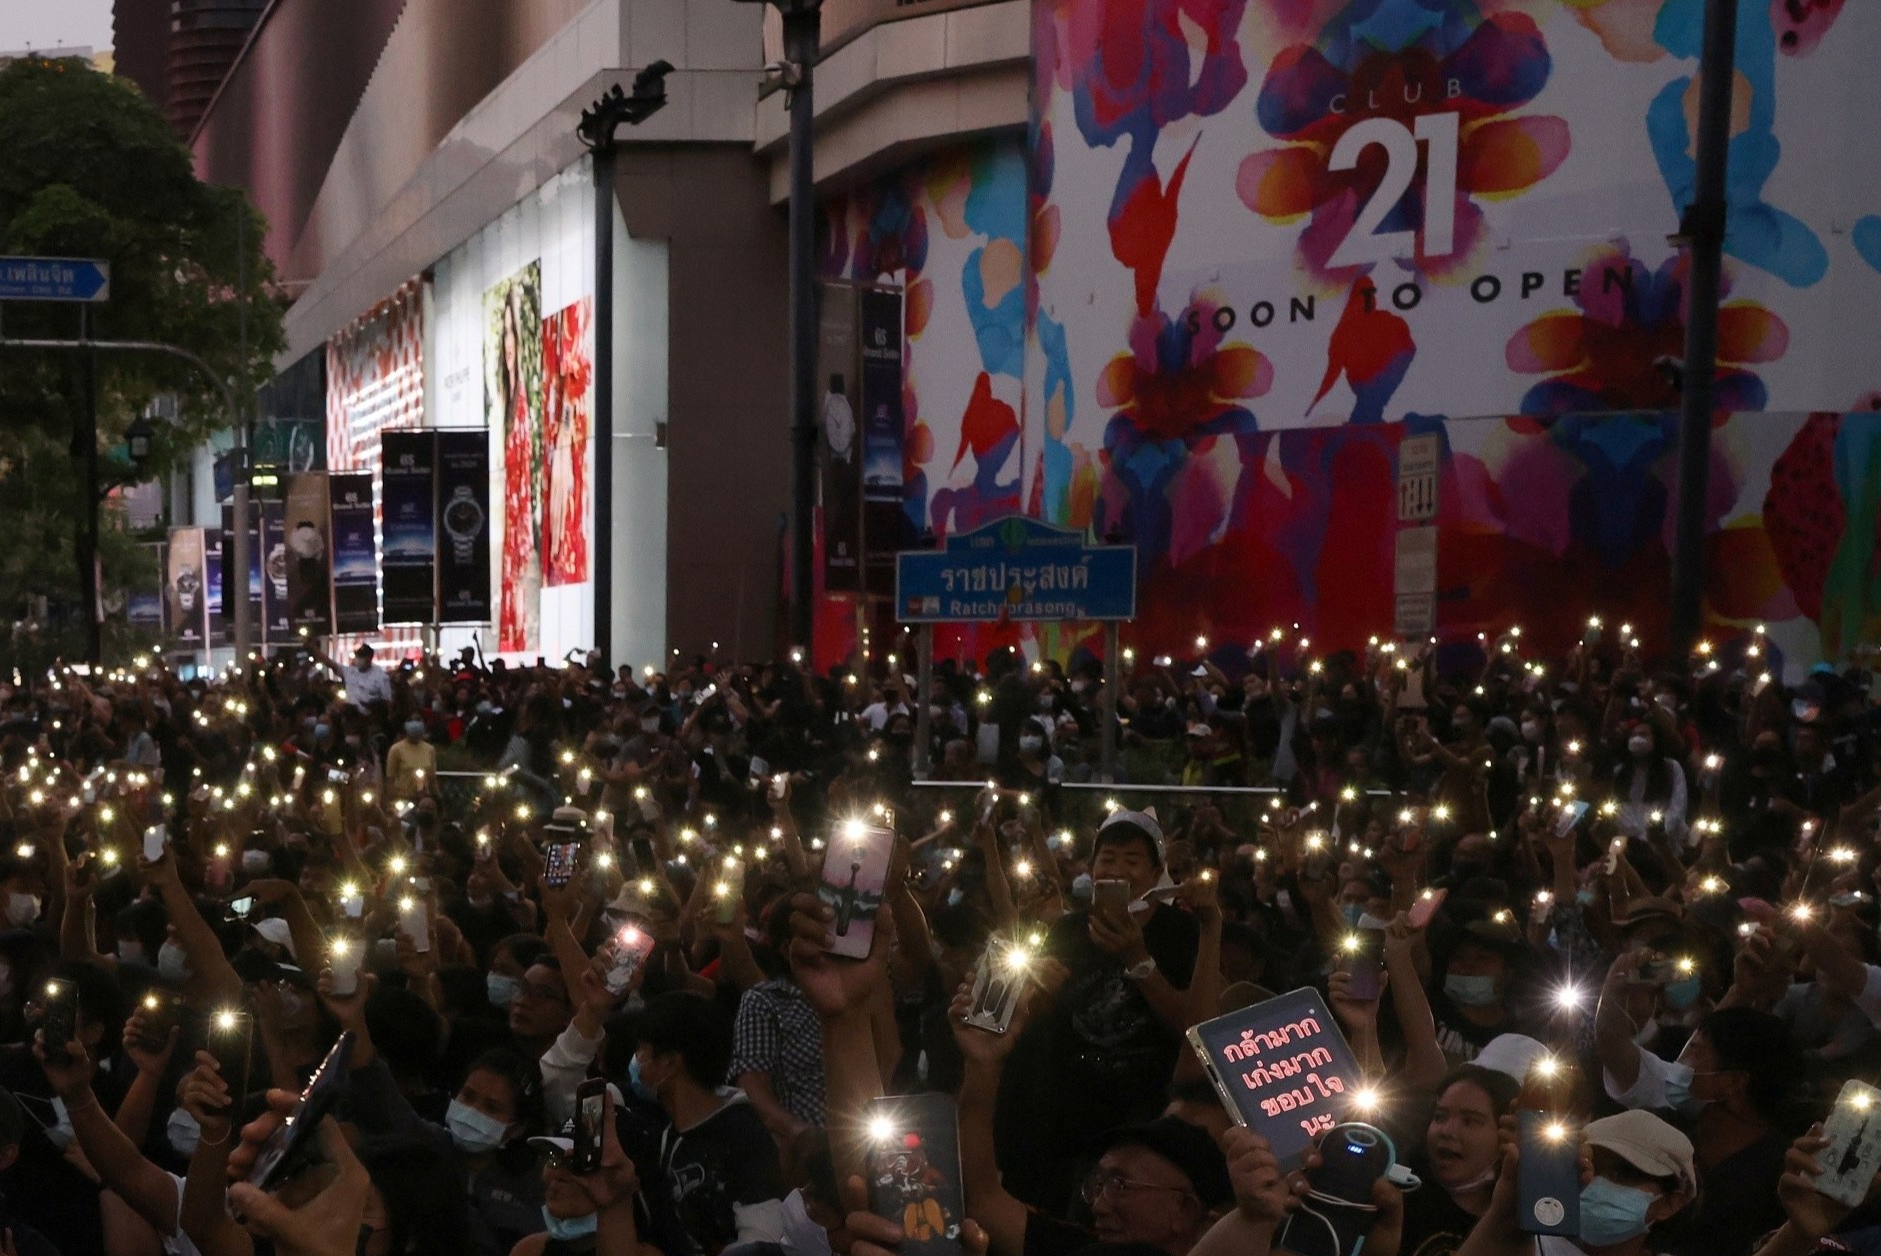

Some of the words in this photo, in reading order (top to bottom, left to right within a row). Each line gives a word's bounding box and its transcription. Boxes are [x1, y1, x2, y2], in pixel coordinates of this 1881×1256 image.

[1329, 78, 1461, 114] CLUB
[1323, 110, 1461, 271] 21
[1186, 294, 1316, 335] SOON
[1361, 281, 1423, 314] TO
[1470, 265, 1633, 303] OPEN
[940, 554, 1093, 593] ราชประสงค์
[950, 600, 1077, 617] Ratchprasong
[1223, 1017, 1321, 1064] กล้ามาก
[1241, 1046, 1333, 1090] เก่งมาก
[1260, 1072, 1345, 1118] ขอบใจ
[1300, 1113, 1336, 1137] นะ
